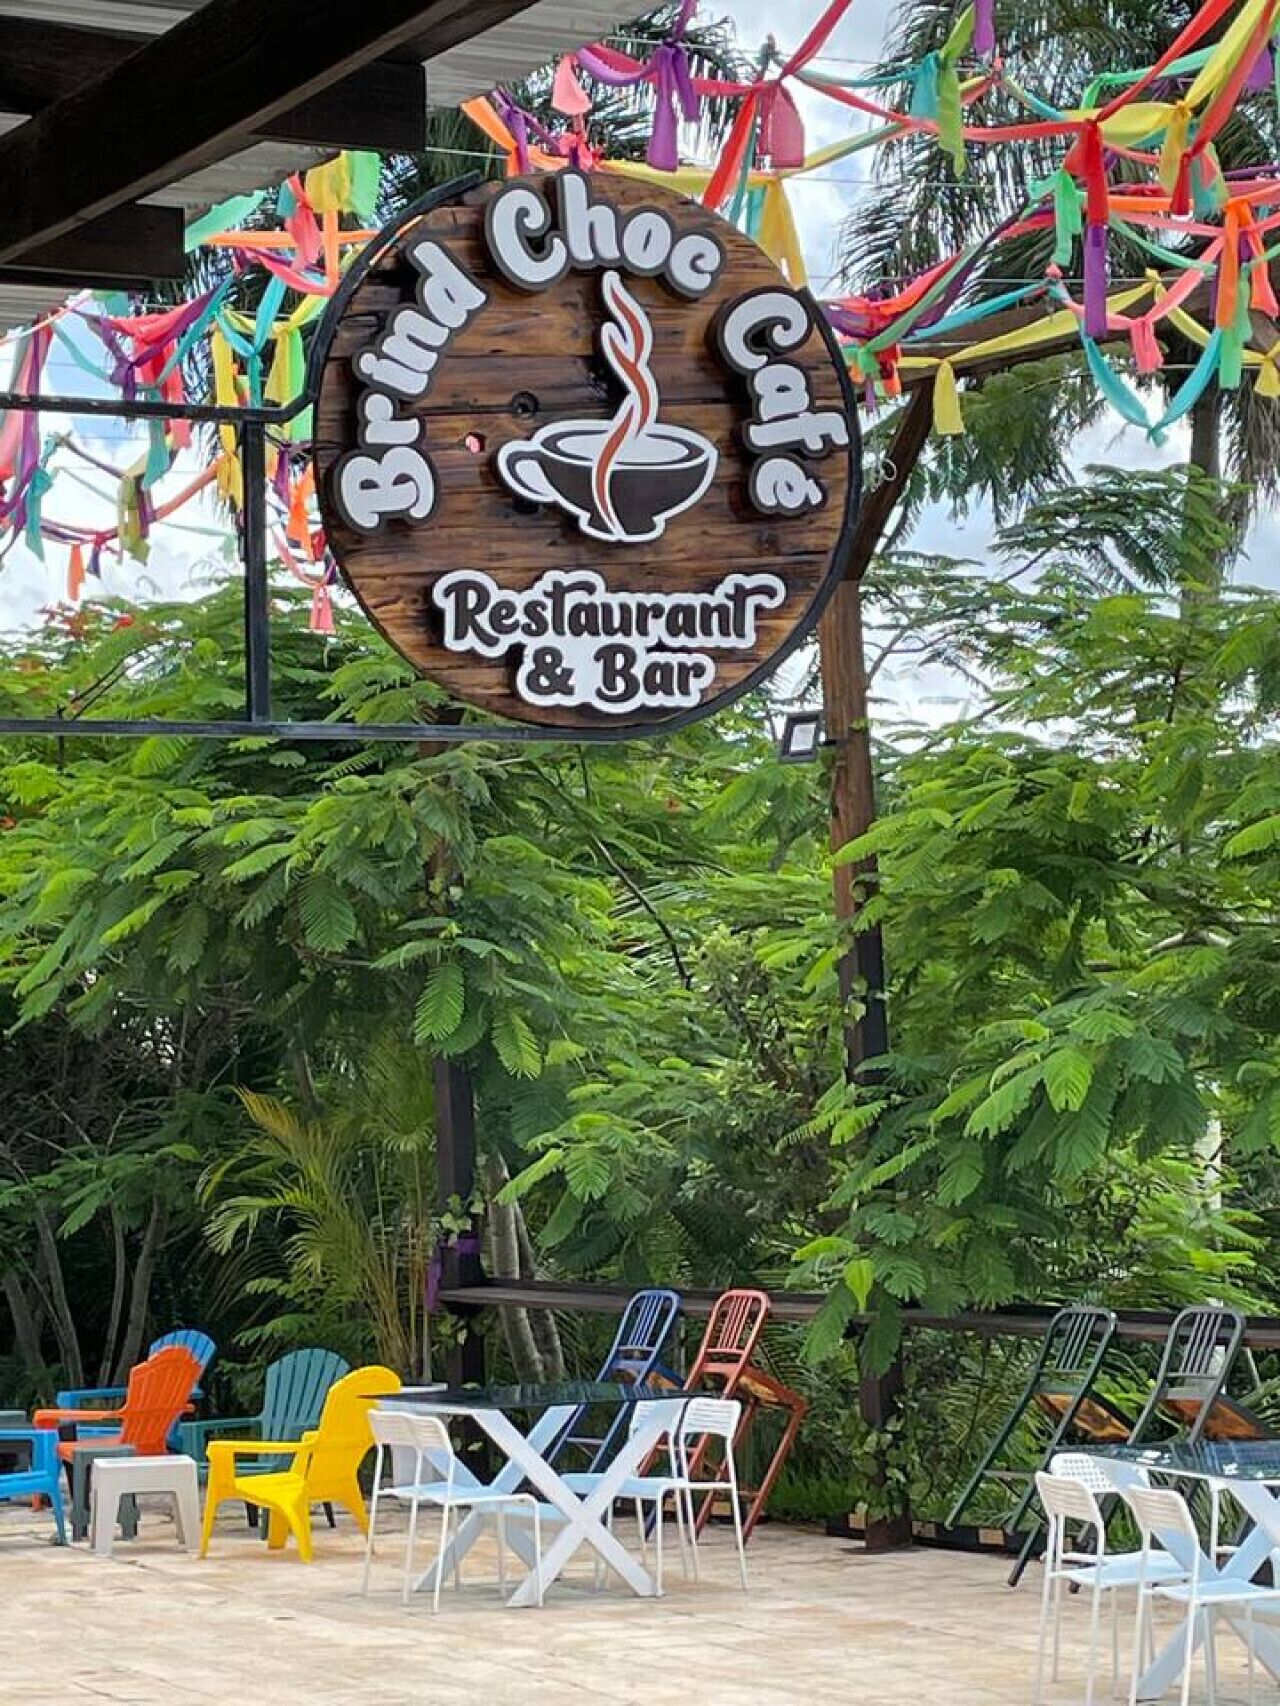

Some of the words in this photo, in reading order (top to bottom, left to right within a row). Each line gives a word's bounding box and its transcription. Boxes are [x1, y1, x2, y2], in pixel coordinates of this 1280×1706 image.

[340, 240, 487, 528] Brind
[489, 172, 720, 293] Choc
[722, 291, 849, 512] Café
[443, 578, 778, 645] Restaurant
[527, 646, 574, 695] &
[595, 644, 708, 701] Bar
